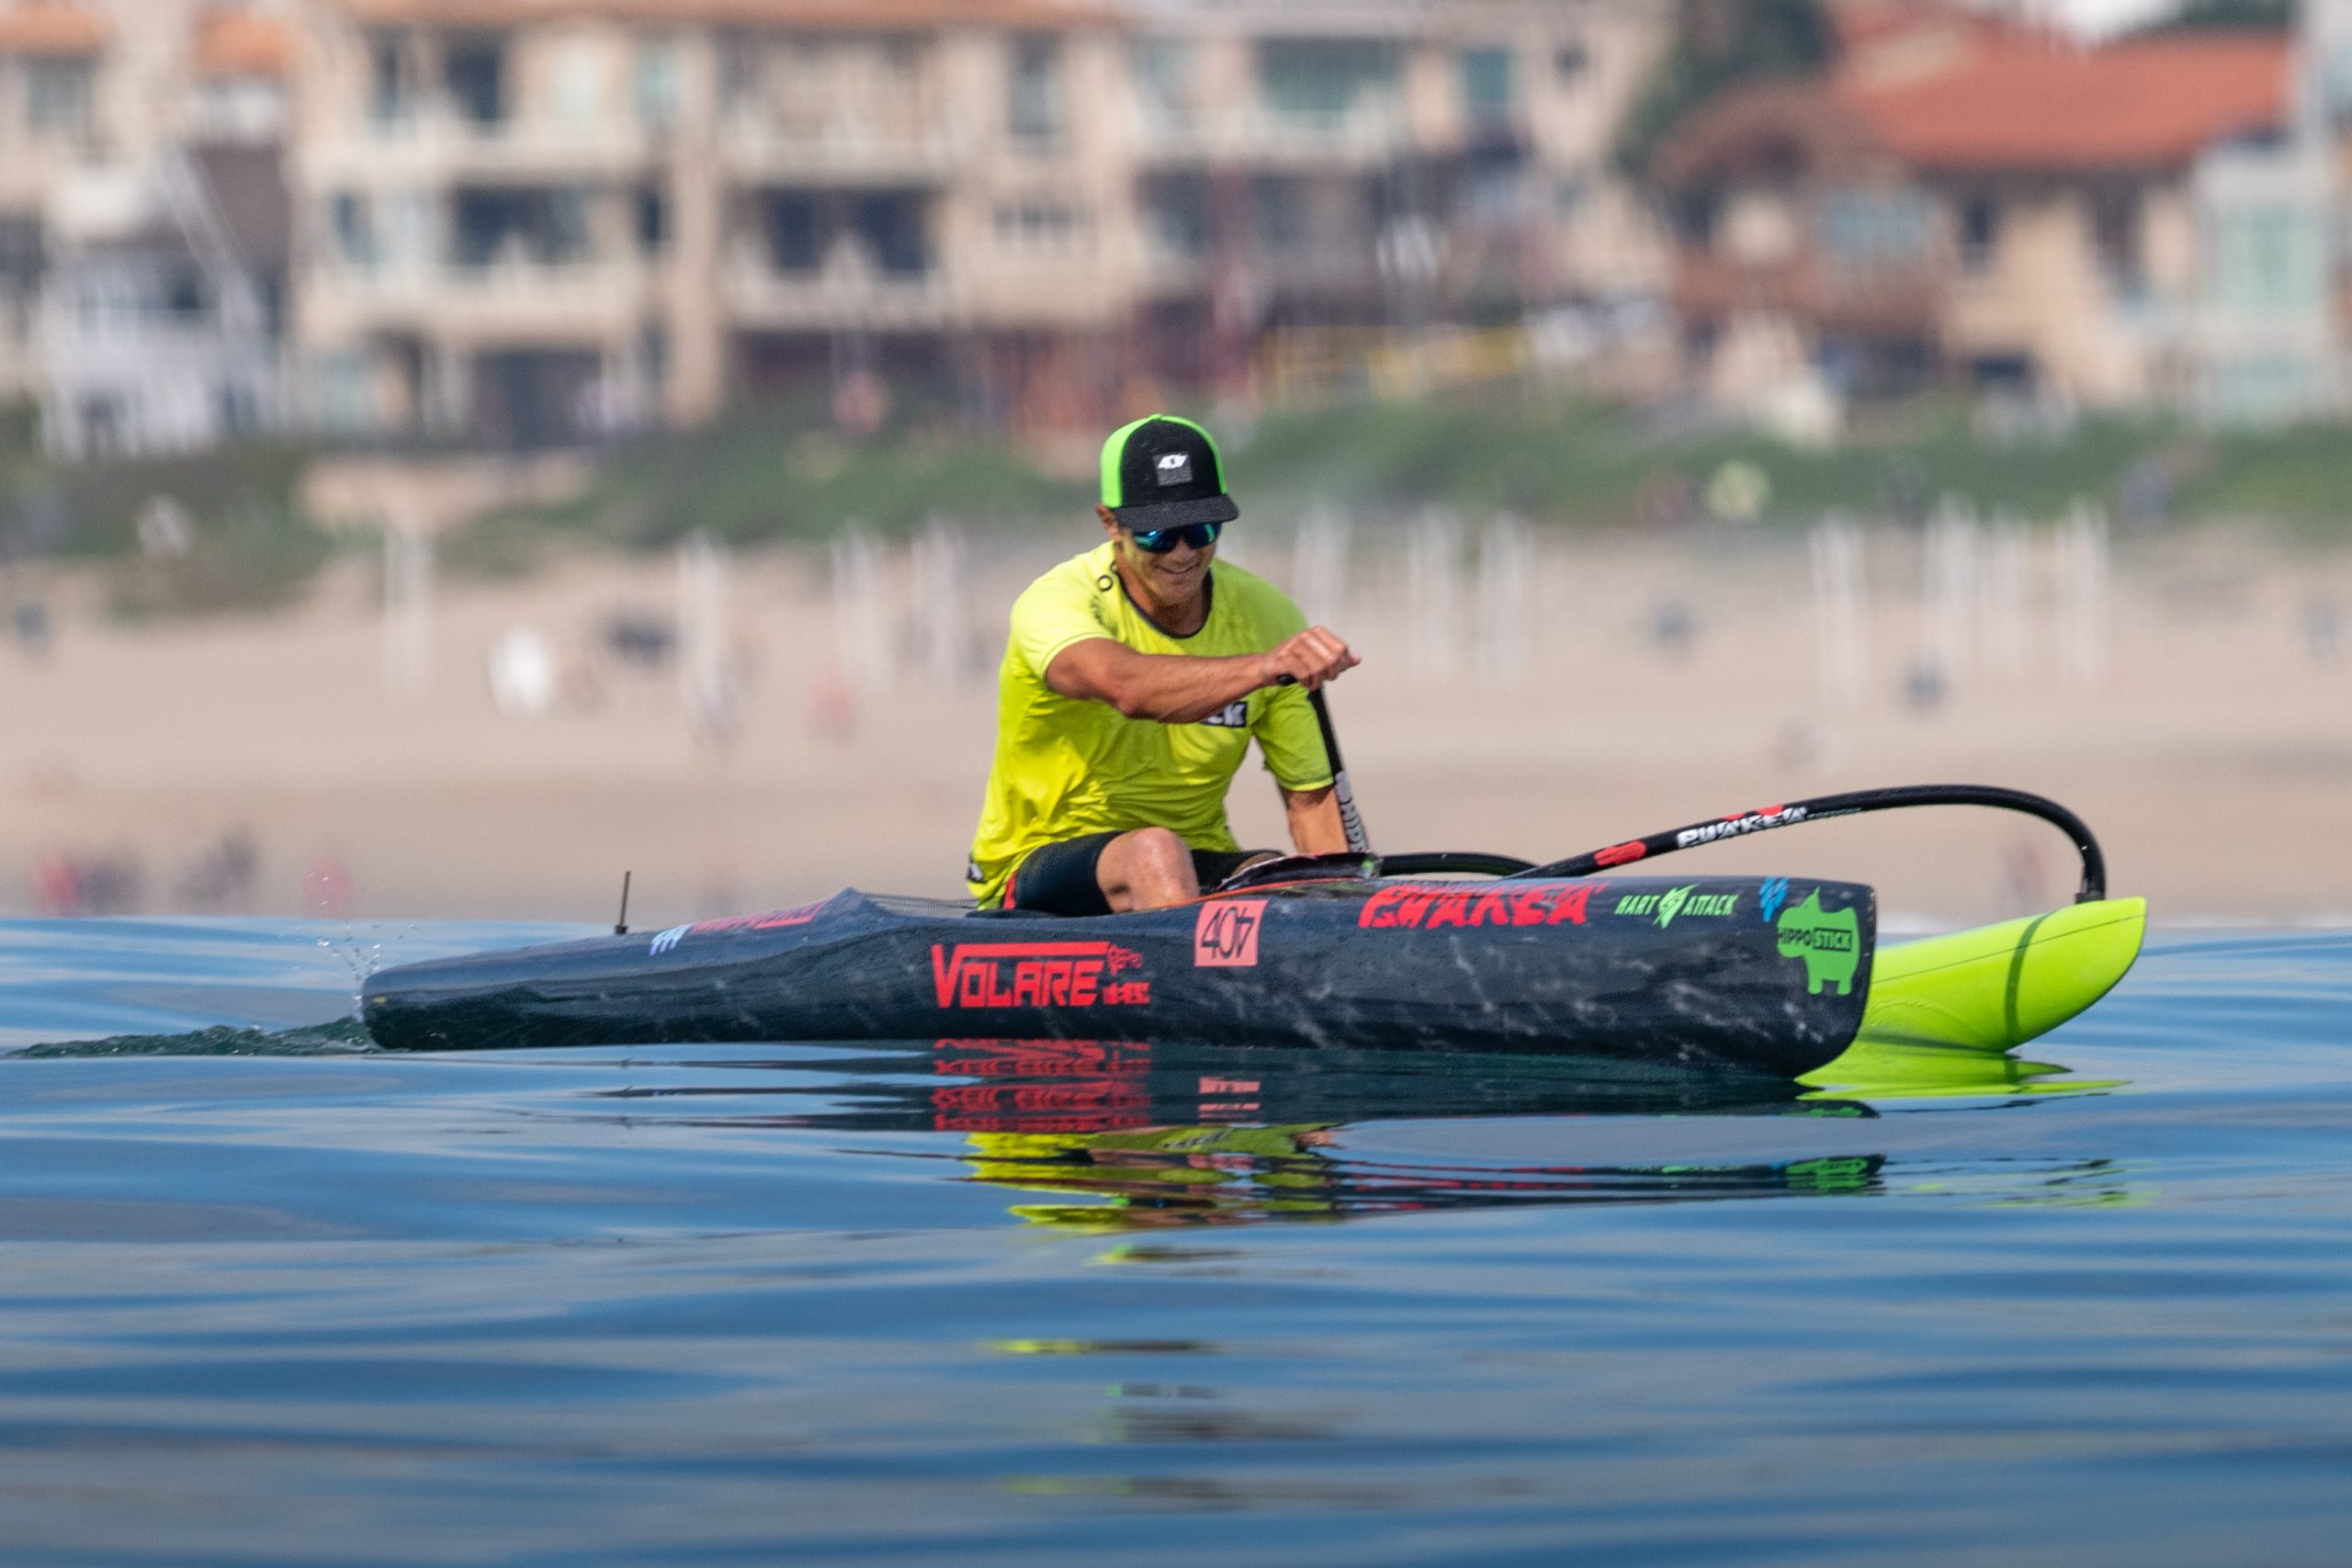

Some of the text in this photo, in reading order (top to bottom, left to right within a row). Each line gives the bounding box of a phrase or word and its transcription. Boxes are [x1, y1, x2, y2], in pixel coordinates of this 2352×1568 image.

[1201, 906, 1256, 959] 407
[1613, 895, 1739, 917] HART ATTACK
[931, 941, 1110, 1009] VOLARE
